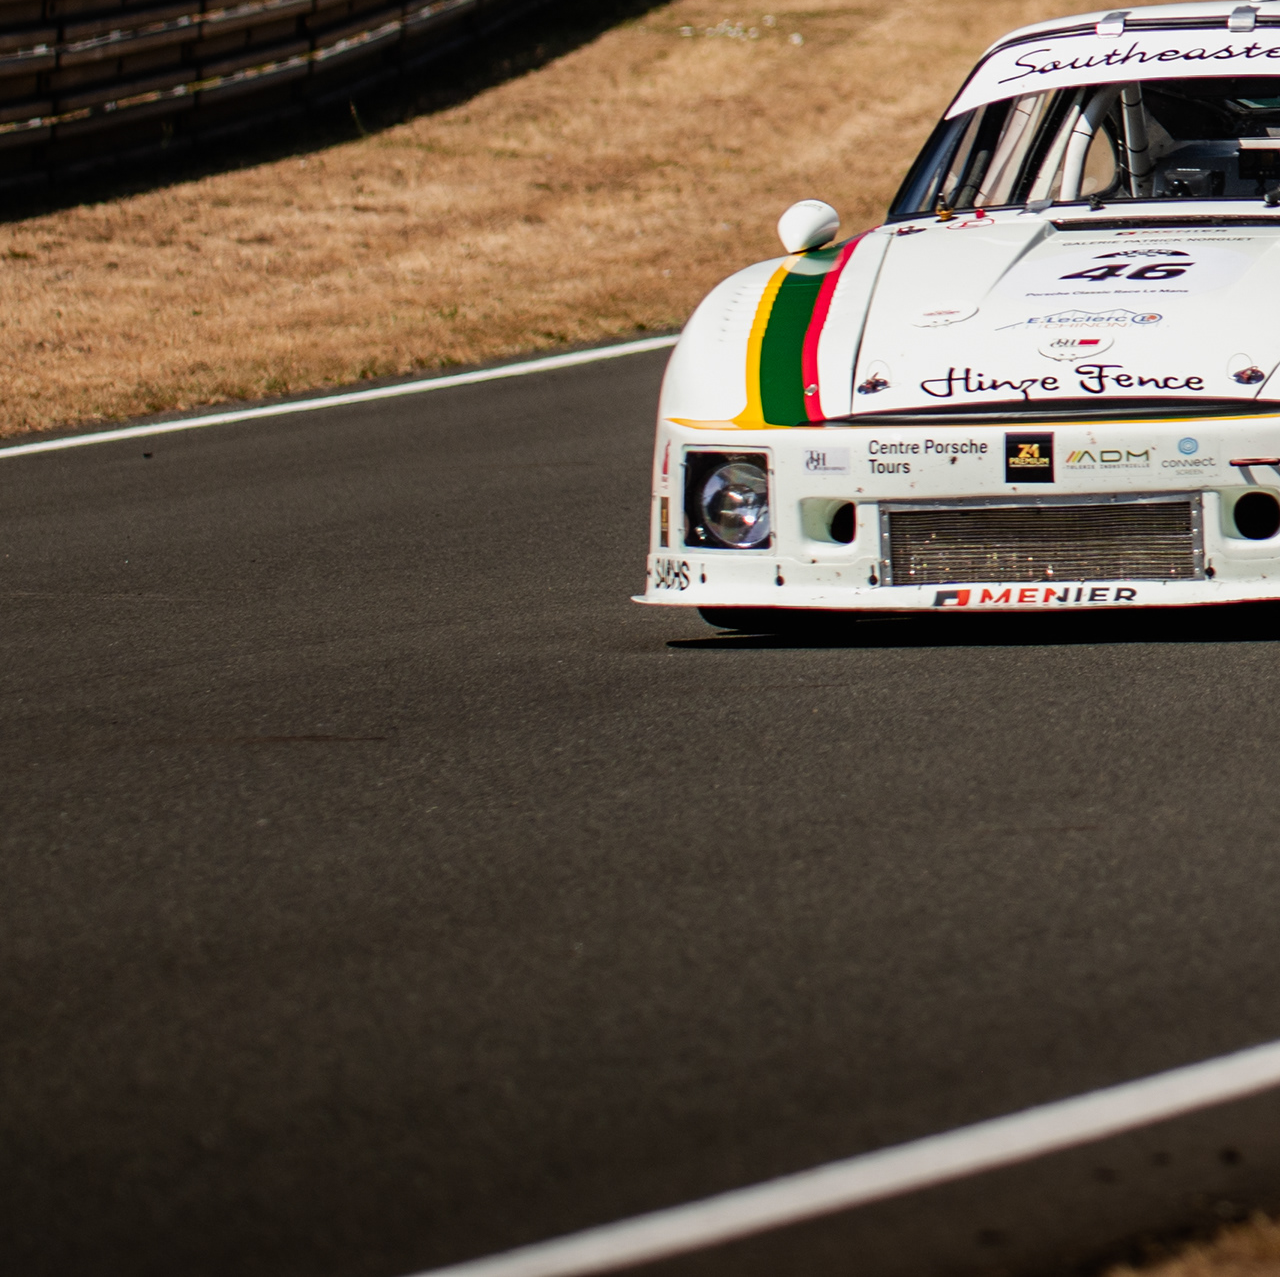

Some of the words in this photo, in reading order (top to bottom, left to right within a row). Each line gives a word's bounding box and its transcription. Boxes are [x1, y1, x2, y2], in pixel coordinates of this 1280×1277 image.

[1062, 239, 1120, 247] GALERIE
[1058, 261, 1196, 282] 46
[921, 366, 1060, 401] Hinze
[1074, 364, 1205, 394] Fence
[868, 439, 920, 455] Centre
[924, 439, 988, 454] Porsche
[868, 458, 911, 474] Tours
[1009, 457, 1050, 465] PREMIUM
[977, 587, 1138, 604] MENIER
